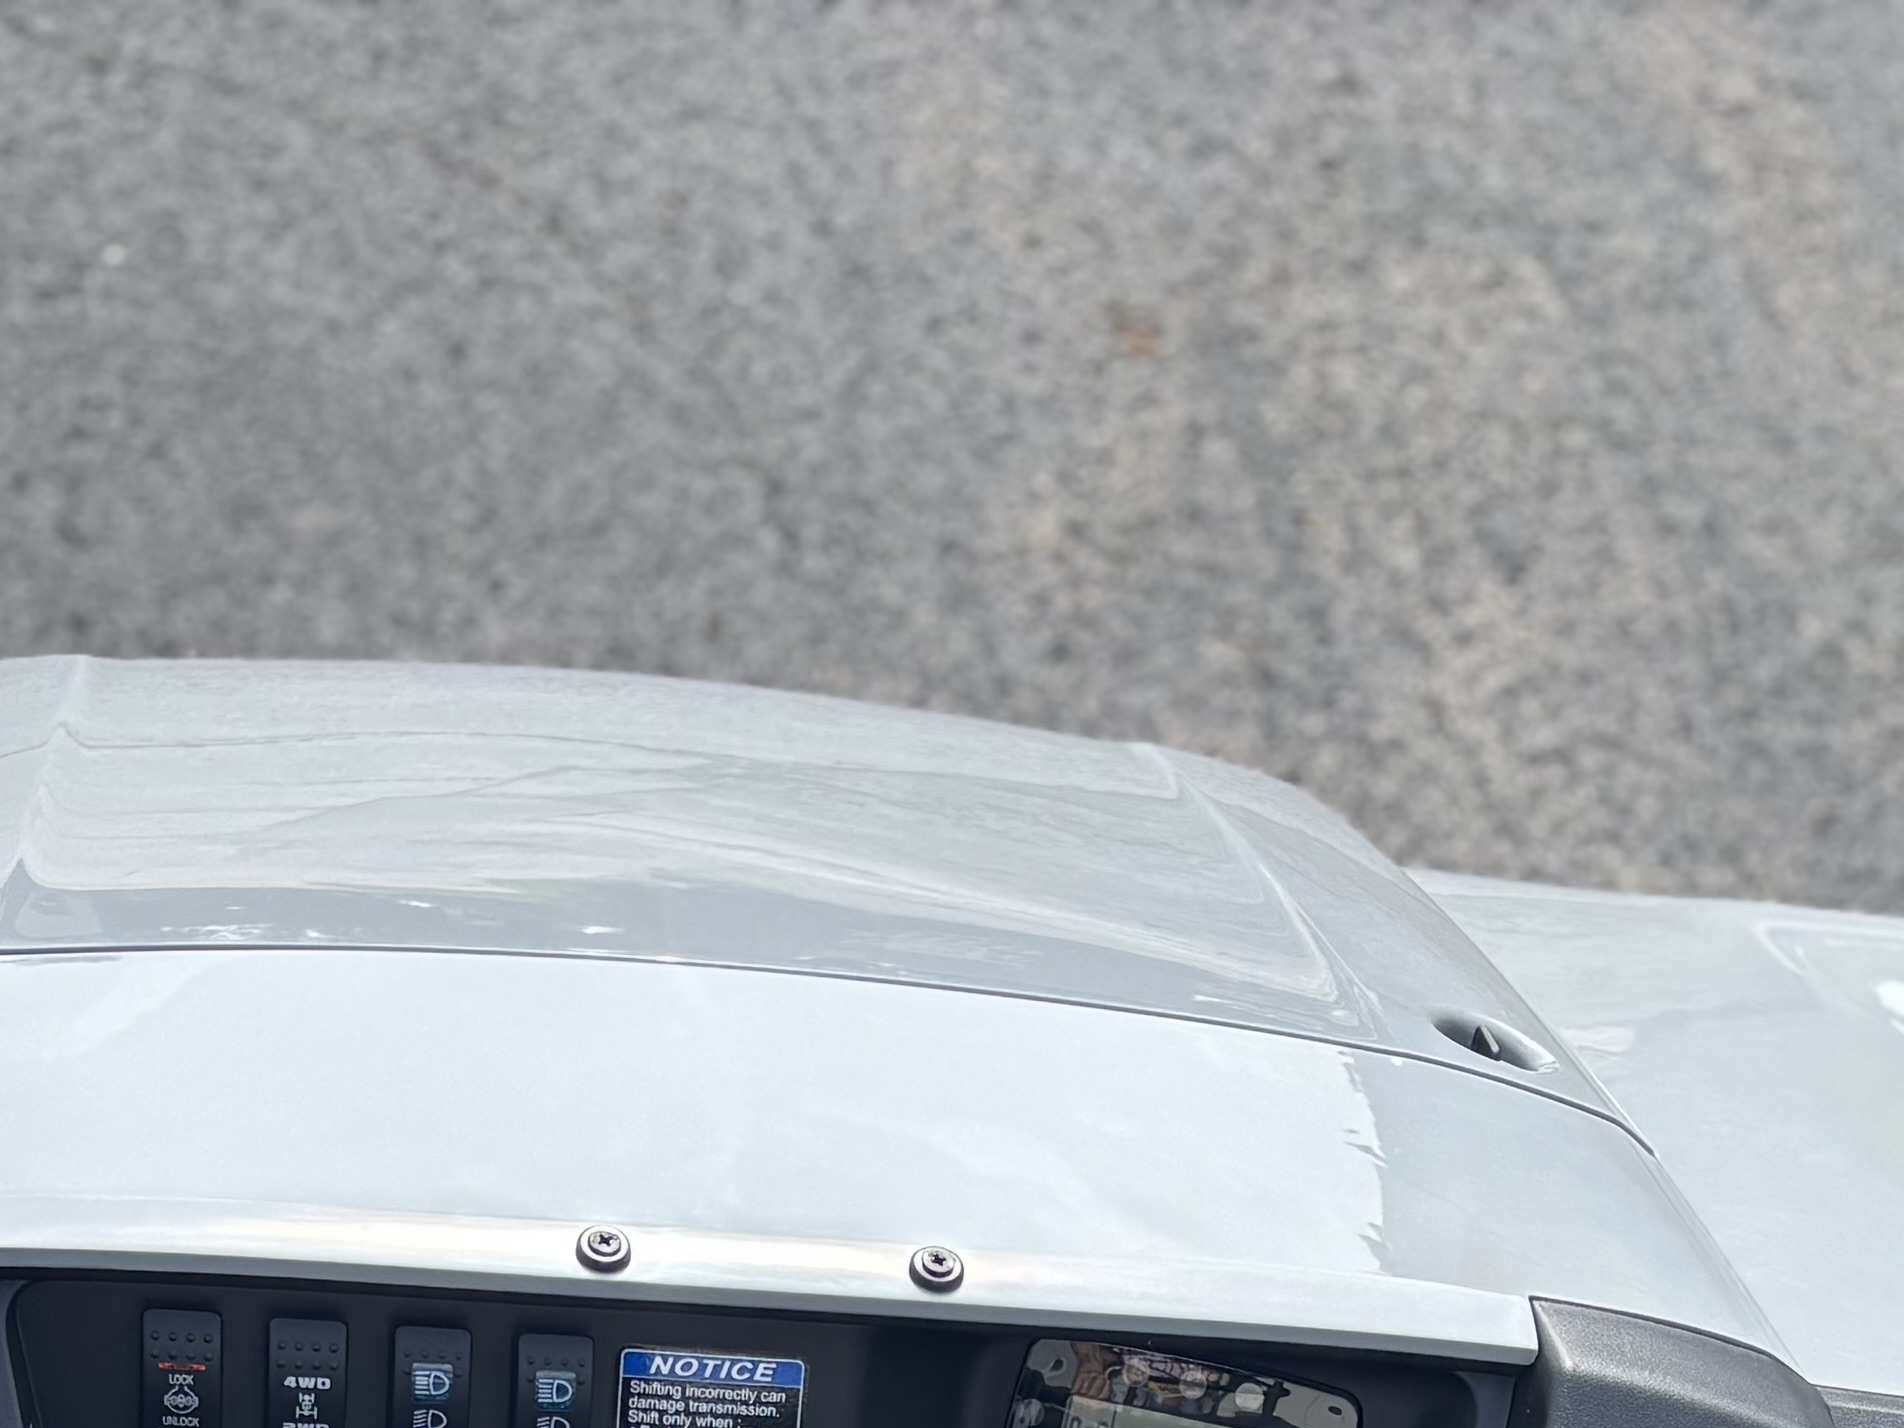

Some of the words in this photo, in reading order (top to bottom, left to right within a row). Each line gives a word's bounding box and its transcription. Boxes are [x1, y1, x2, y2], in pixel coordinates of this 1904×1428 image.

[649, 1356, 778, 1382] NOTICE
[168, 1374, 194, 1385] LOCK
[283, 1376, 331, 1390] 4WD
[630, 1380, 682, 1399] Shifting
[686, 1384, 757, 1404] incorrectly
[761, 1391, 786, 1403] can
[628, 1396, 685, 1414] damage
[689, 1401, 780, 1417] transmission.
[162, 1416, 200, 1427] UNLOCK
[628, 1410, 660, 1424] Shift
[663, 1414, 692, 1428] only
[696, 1416, 733, 1428] when
